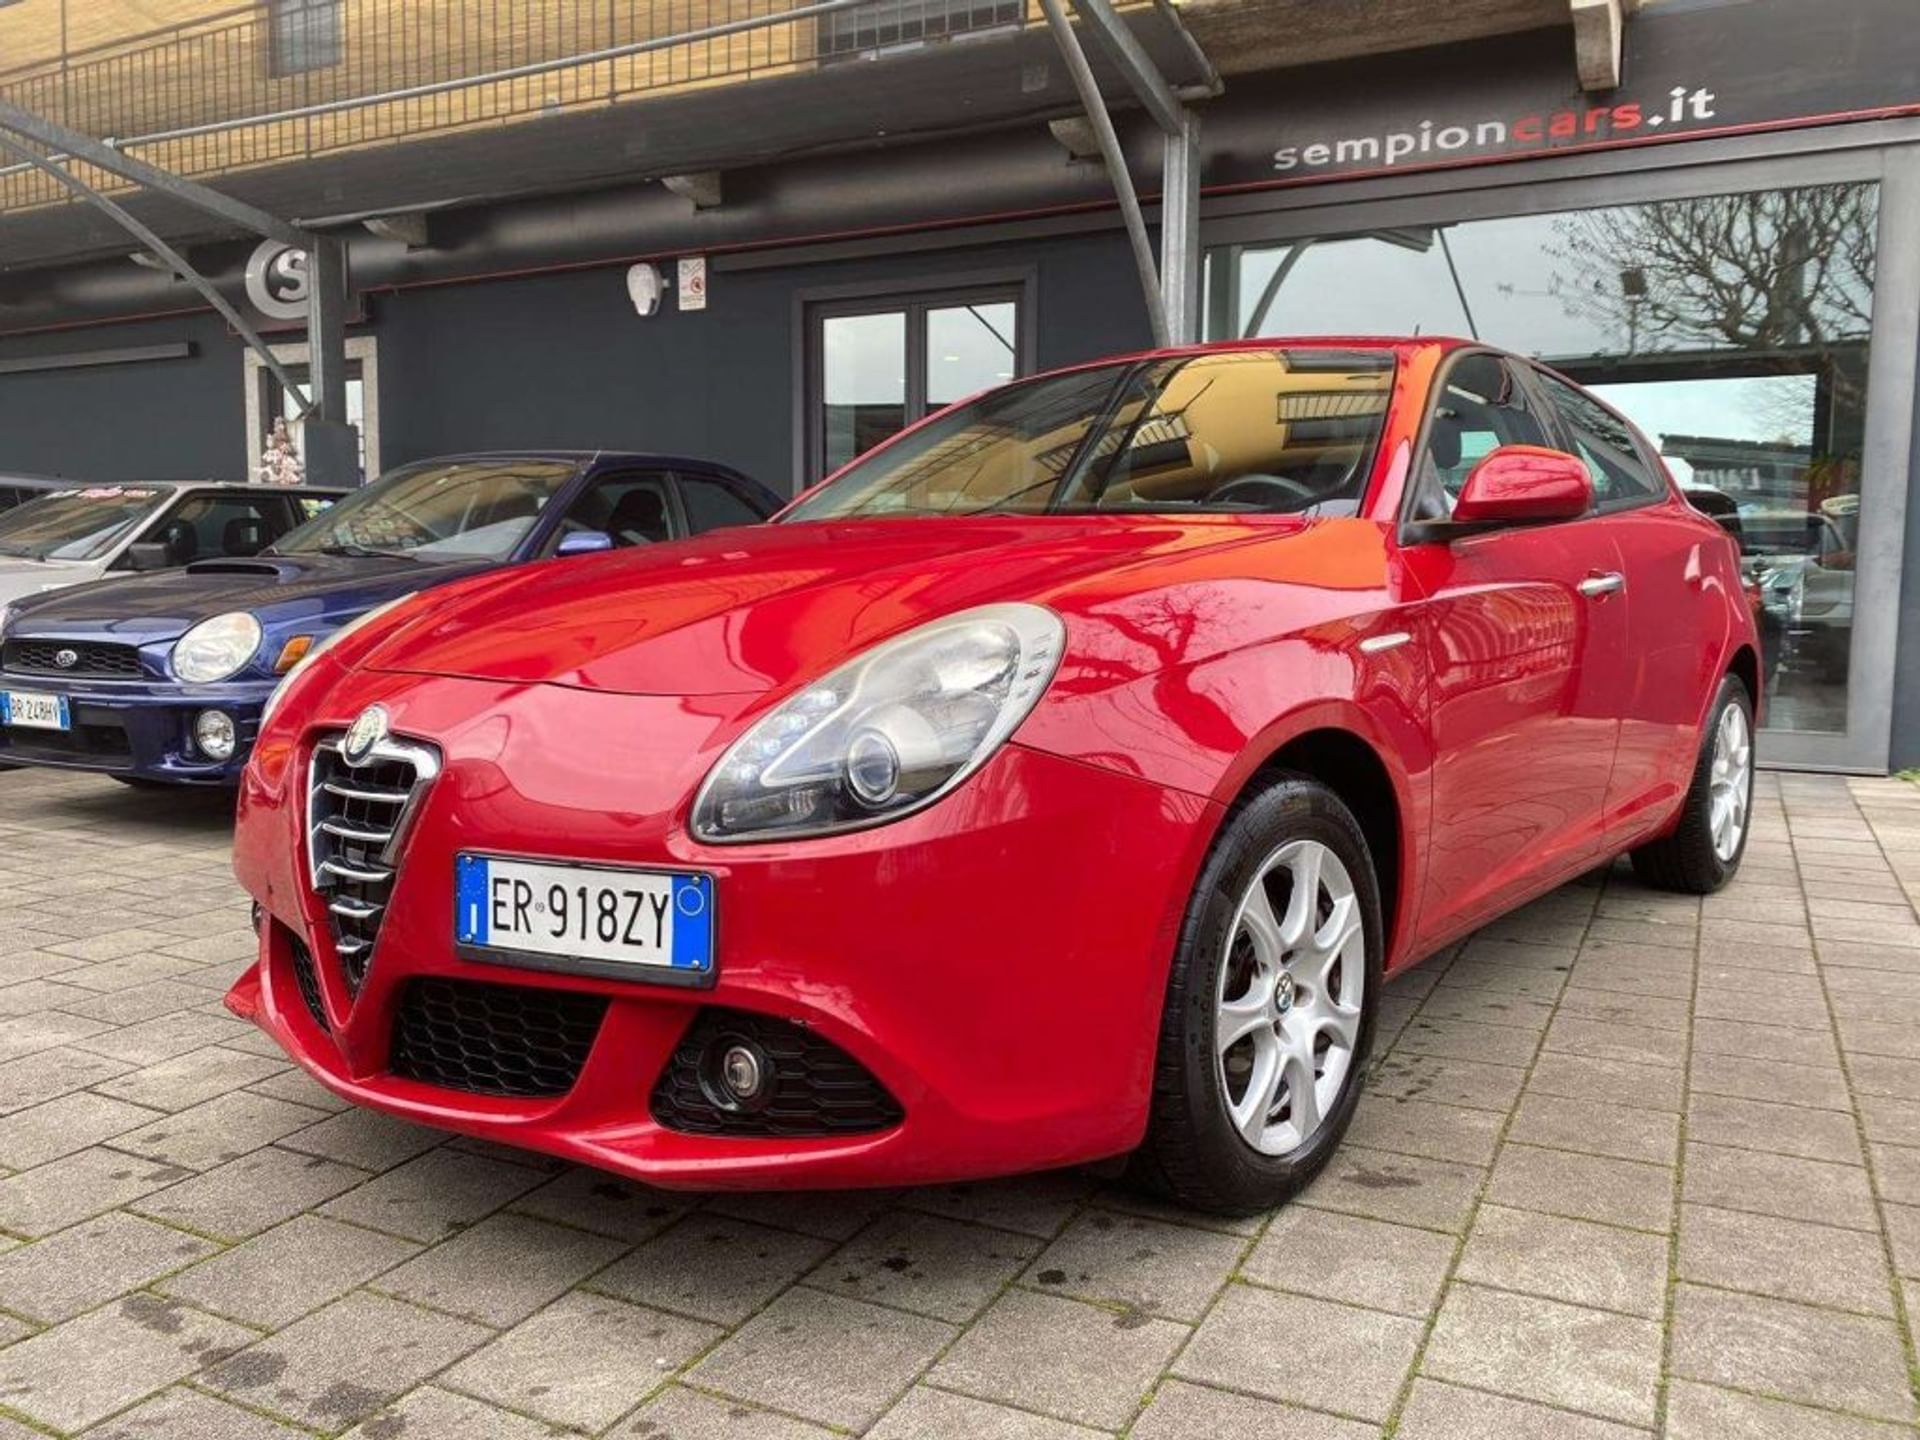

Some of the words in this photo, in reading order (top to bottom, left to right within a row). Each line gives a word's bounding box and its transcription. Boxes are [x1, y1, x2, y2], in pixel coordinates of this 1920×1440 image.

[1273, 86, 1716, 169] sempioncars.it
[492, 877, 532, 934] ER
[549, 884, 669, 948] 918ZY
